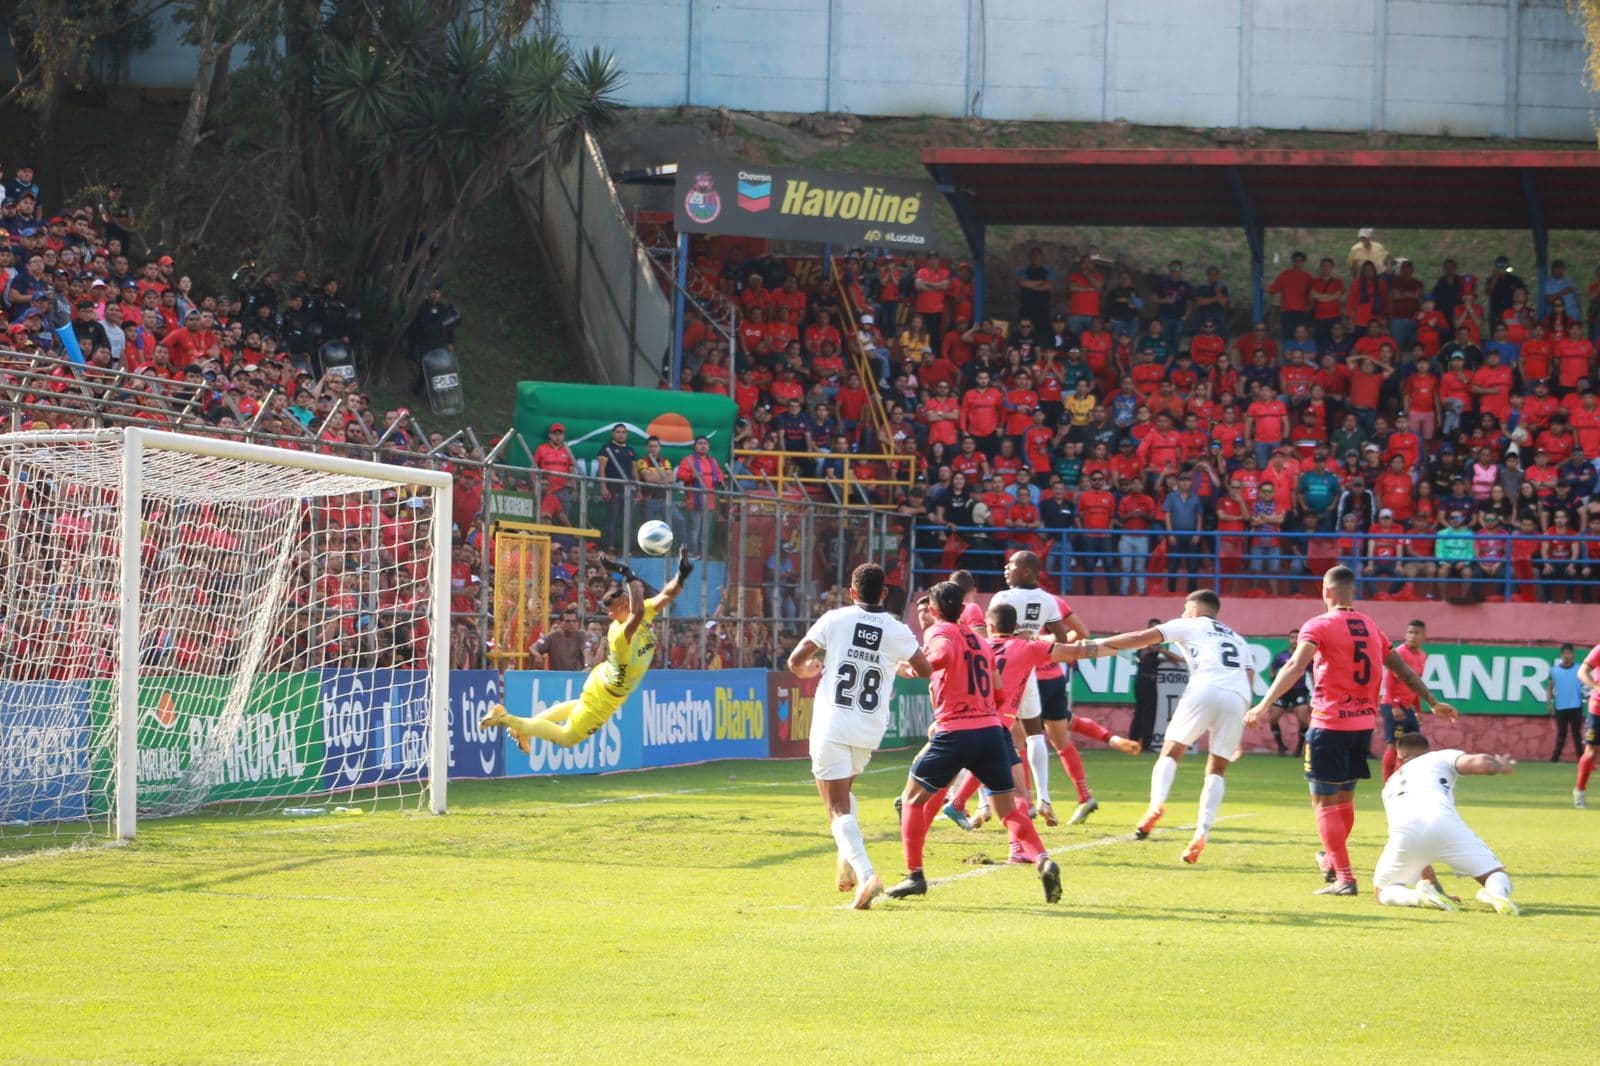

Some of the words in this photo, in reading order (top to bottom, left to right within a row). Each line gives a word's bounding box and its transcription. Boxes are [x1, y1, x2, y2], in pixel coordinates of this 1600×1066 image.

[781, 179, 921, 225] Havoline
[857, 629, 879, 645] tigo
[1220, 642, 1241, 668] 2
[965, 650, 990, 698] 16
[1353, 640, 1371, 685] 5
[834, 662, 884, 714] 28
[642, 689, 712, 747] Nuestro
[715, 687, 764, 741] Diario
[137, 745, 183, 781] ANRURAL
